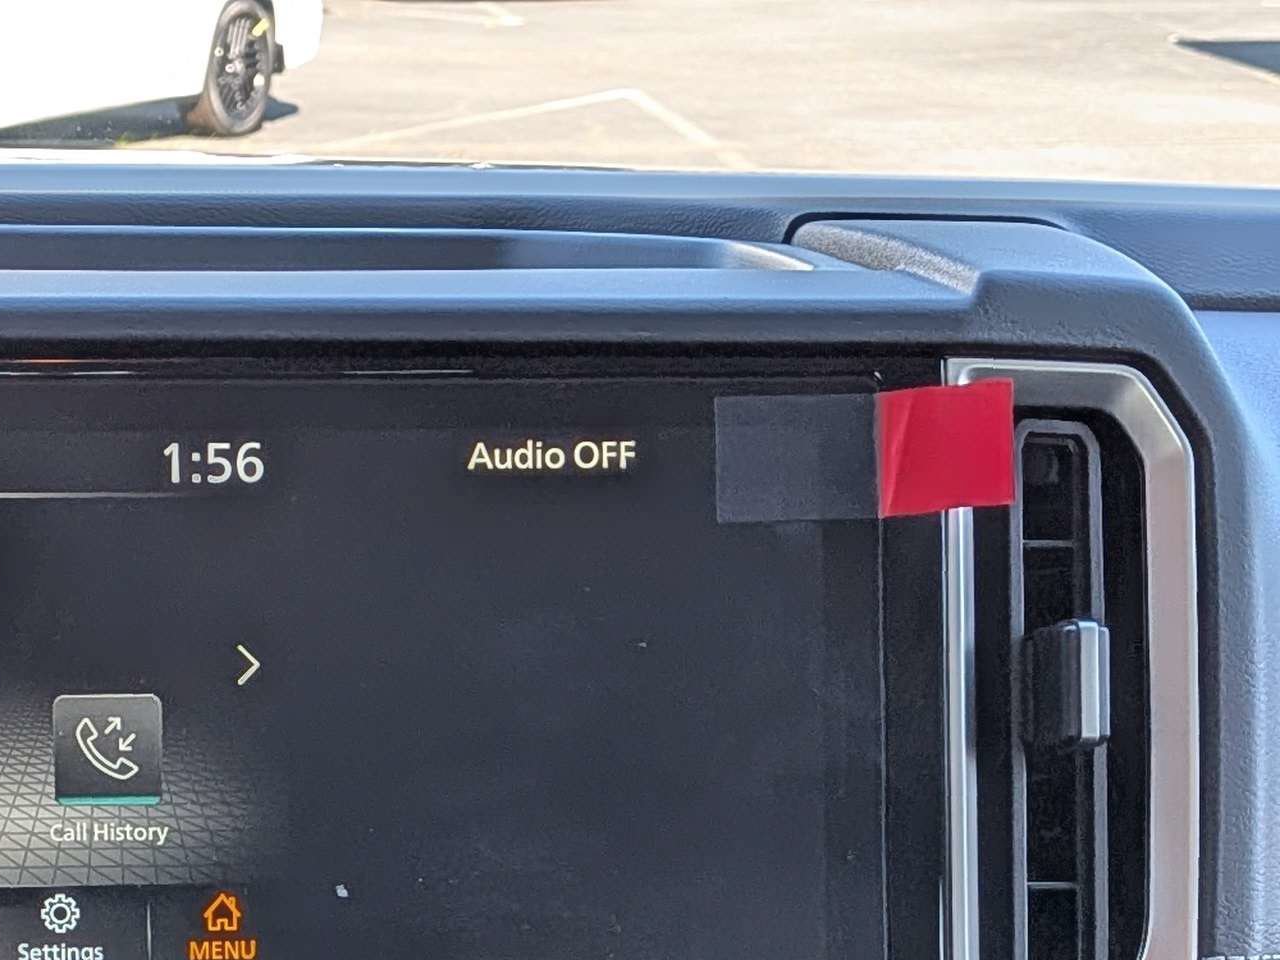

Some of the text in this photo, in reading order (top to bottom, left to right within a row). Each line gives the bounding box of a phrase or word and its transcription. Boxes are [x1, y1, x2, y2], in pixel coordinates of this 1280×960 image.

[163, 442, 264, 484] 1:56
[468, 439, 636, 470] Audio OFF
[48, 822, 168, 845] Call History
[189, 940, 257, 960] MENU
